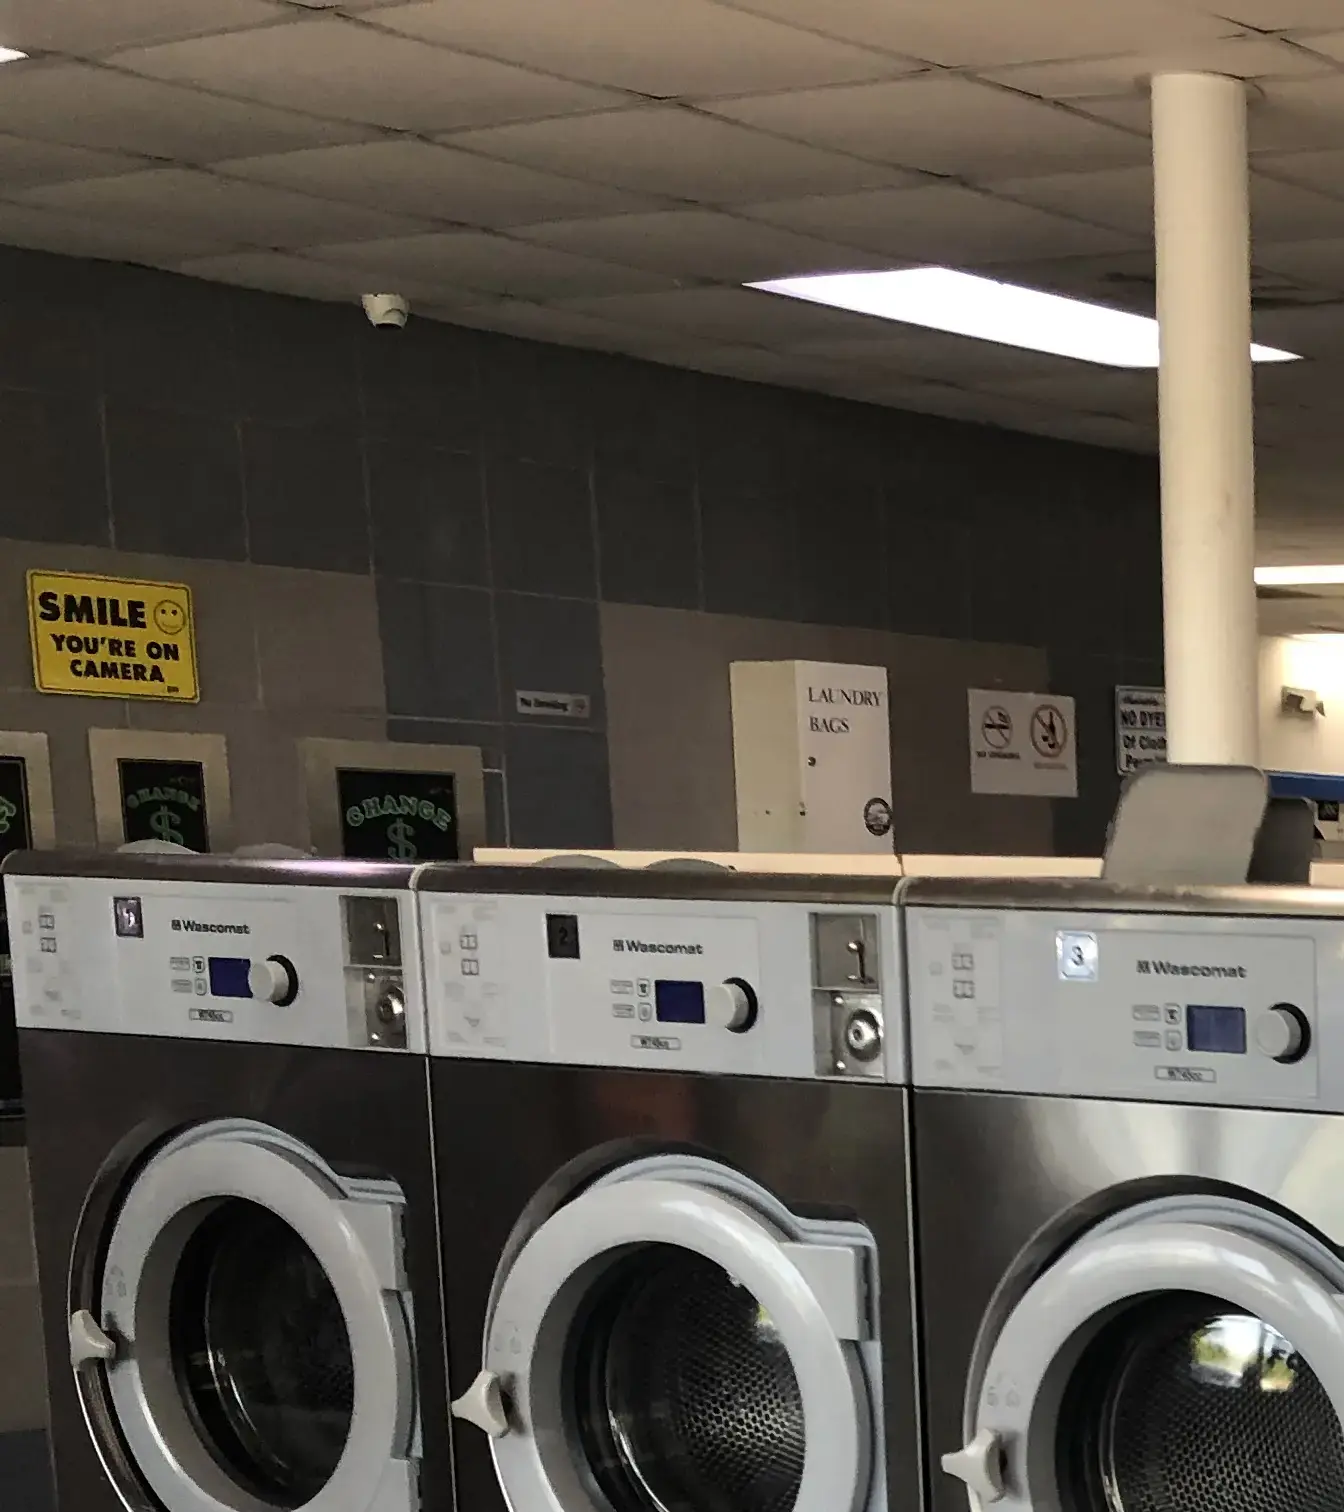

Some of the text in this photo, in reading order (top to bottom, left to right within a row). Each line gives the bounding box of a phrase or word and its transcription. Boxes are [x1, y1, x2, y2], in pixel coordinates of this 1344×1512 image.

[38, 591, 147, 629] SMILE
[49, 633, 180, 661] YOU'RE ON
[69, 659, 165, 683] CAMERA
[808, 686, 882, 707] LAUNDRY
[809, 715, 850, 734] BAGS
[1121, 709, 1137, 726] NO
[346, 794, 452, 832] CHANGE
[182, 919, 250, 935] Wascomat
[558, 926, 569, 947] 2
[626, 939, 704, 955] Wascomat
[1070, 945, 1085, 967] 3
[1151, 960, 1248, 979] Wascomat
